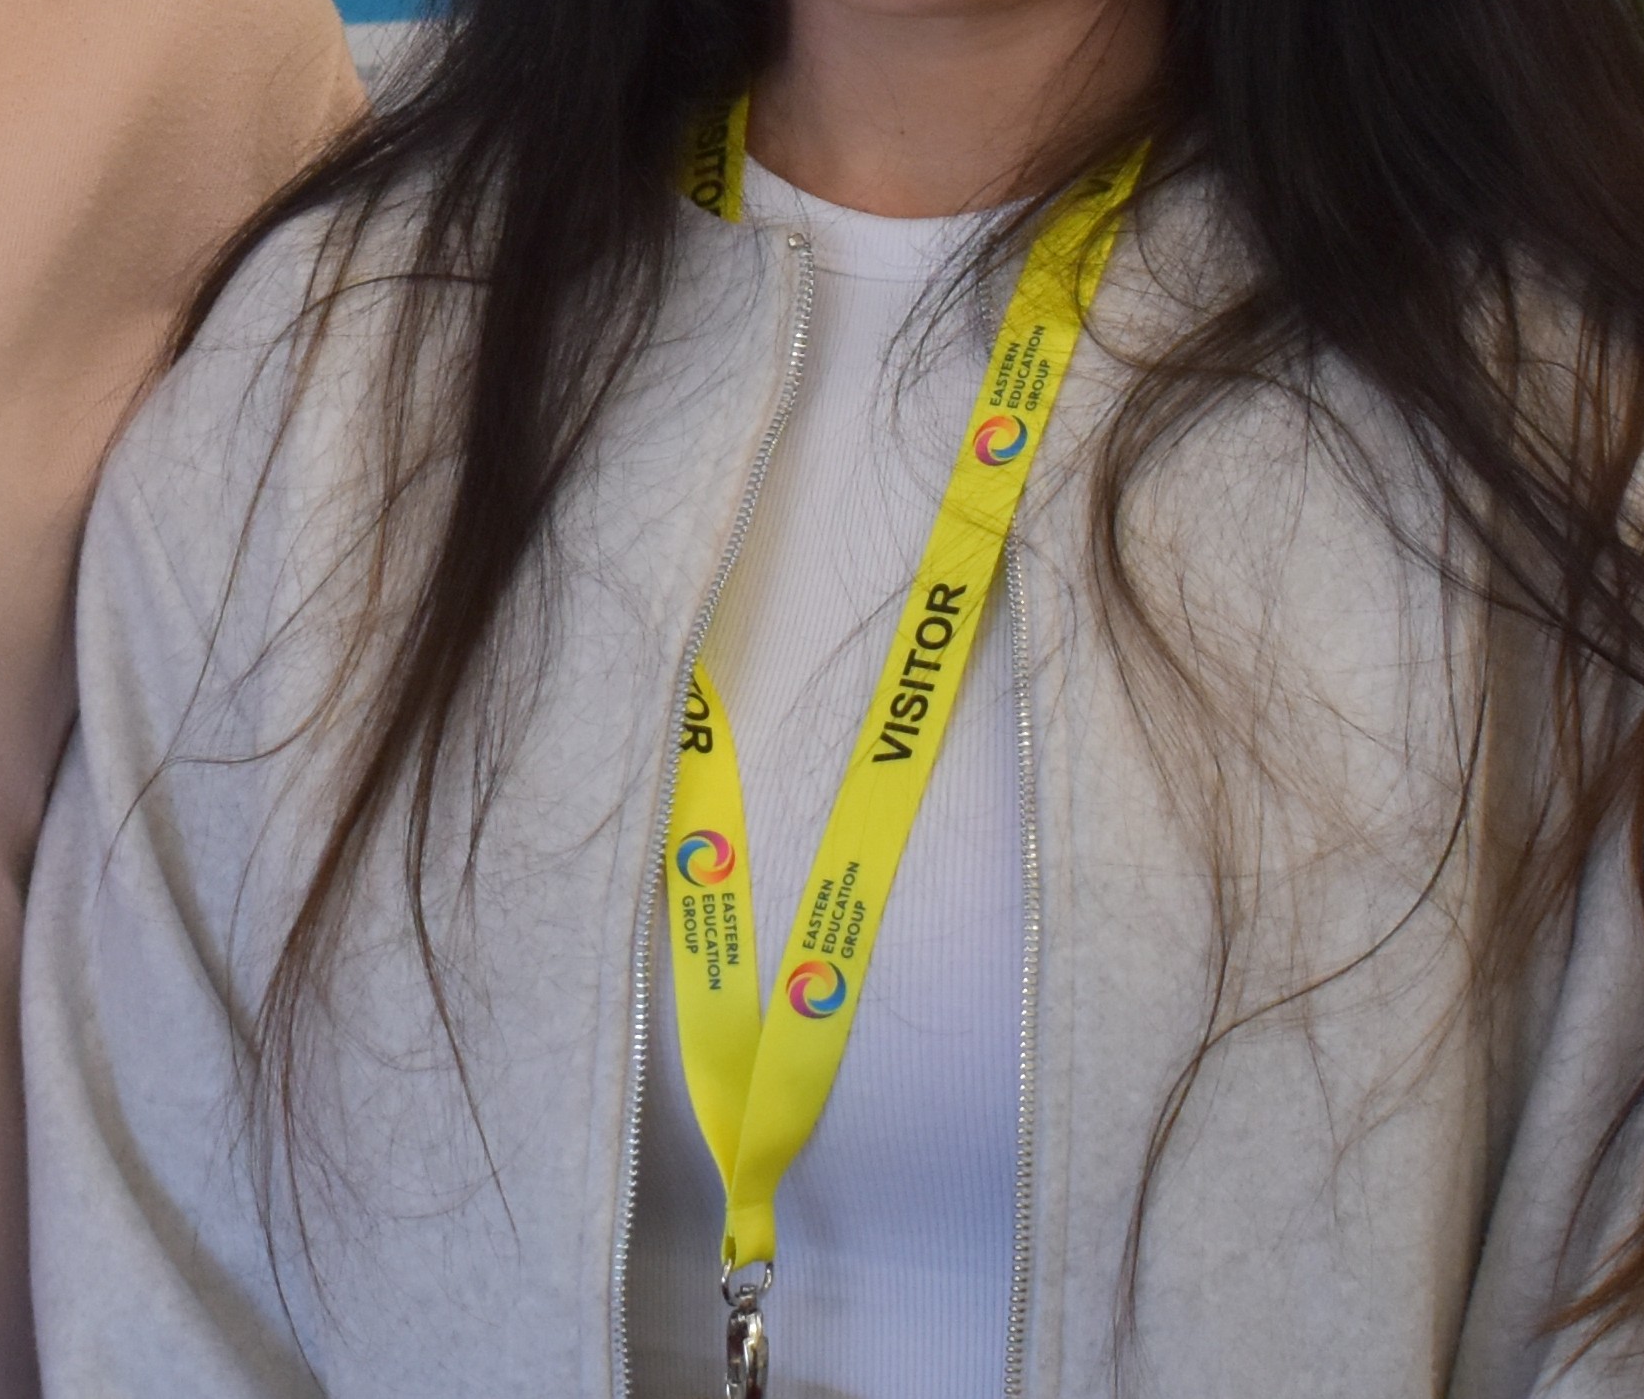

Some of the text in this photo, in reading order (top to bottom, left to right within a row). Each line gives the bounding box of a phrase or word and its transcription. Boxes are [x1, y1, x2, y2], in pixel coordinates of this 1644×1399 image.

[989, 341, 1020, 407] EASTERN
[1006, 324, 1046, 410] EDUCATION
[1024, 358, 1051, 412] GROUP
[871, 582, 968, 763] VISITOR
[682, 894, 699, 954] GROUP
[701, 893, 721, 991] EDUCATION
[721, 891, 740, 965] EASTERN
[803, 878, 835, 950] EASTERN
[821, 861, 860, 954] EDUCATION
[840, 900, 868, 960] GROUP
